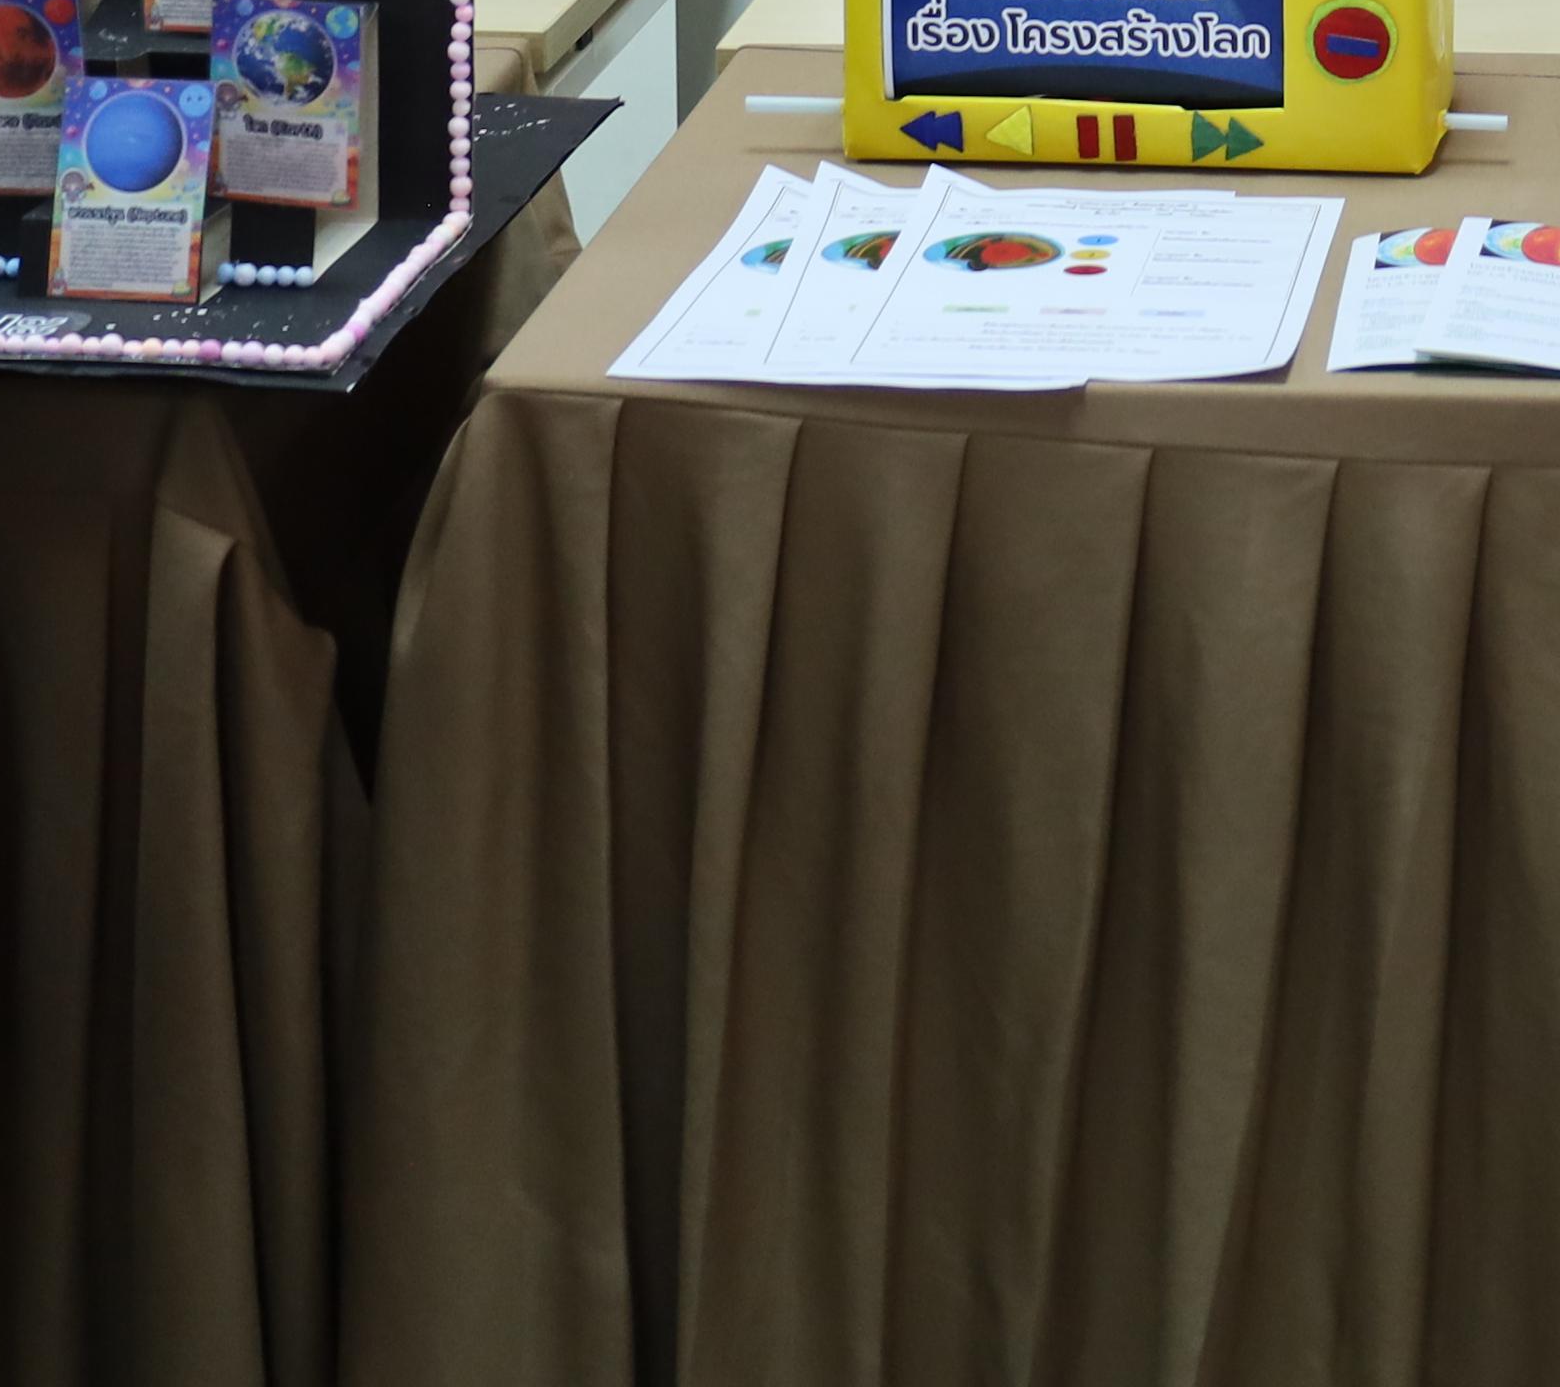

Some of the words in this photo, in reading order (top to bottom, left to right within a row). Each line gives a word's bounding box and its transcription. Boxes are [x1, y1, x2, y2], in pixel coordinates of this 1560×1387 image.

[1004, 10, 1270, 57] โครงสร้างโลก
